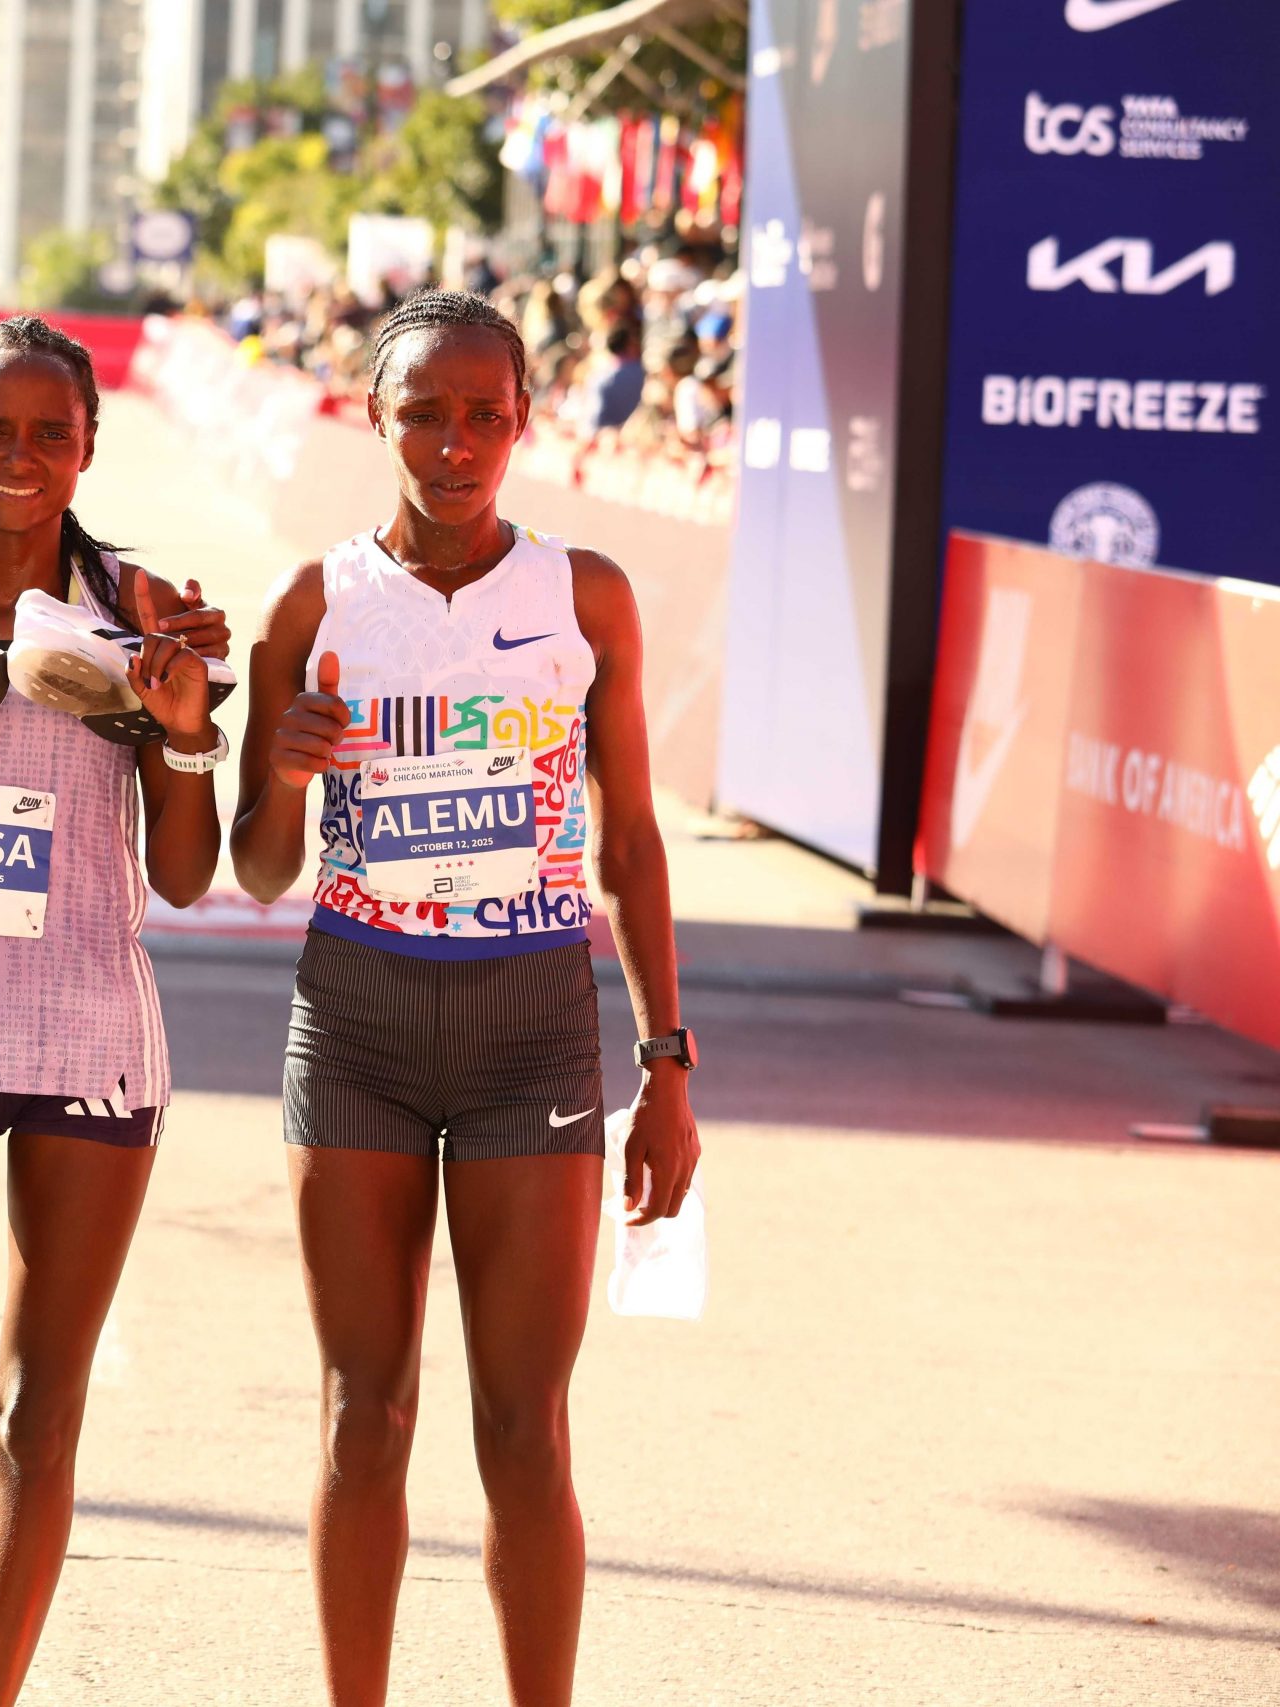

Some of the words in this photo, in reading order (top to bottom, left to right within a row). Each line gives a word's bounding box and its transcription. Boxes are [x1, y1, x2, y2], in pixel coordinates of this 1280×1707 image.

[1024, 90, 1116, 156] tcs
[492, 755, 515, 767] RUN
[393, 772, 427, 782] CHICAGO
[429, 768, 473, 778] MARATHON
[19, 796, 42, 808] RUN
[371, 792, 527, 840] ALEMU
[410, 841, 454, 853] OCTOBER
[456, 840, 469, 849] 12,
[471, 837, 494, 848] 2025
